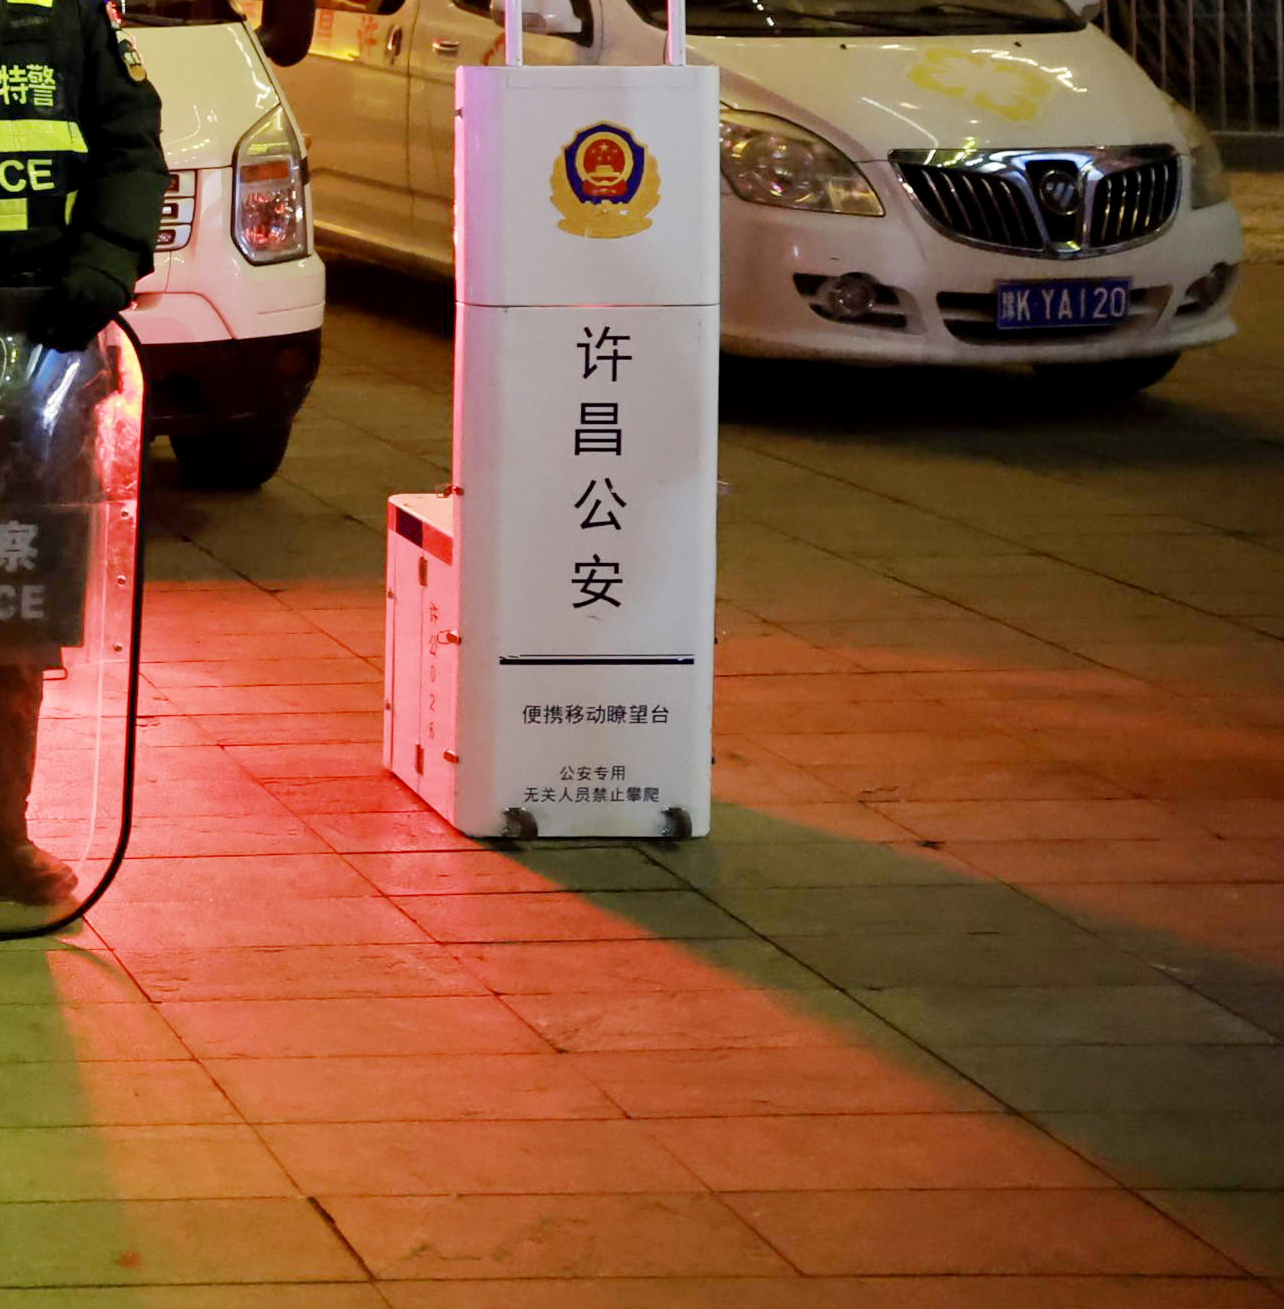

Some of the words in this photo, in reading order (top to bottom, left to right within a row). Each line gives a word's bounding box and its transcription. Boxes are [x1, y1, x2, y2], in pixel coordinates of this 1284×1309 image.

[569, 326, 633, 609] 许昌公安
[522, 704, 669, 725] 便携移动瞭望台
[559, 765, 626, 782] 公安专用
[524, 787, 660, 804] 无关人员禁止攀爬
